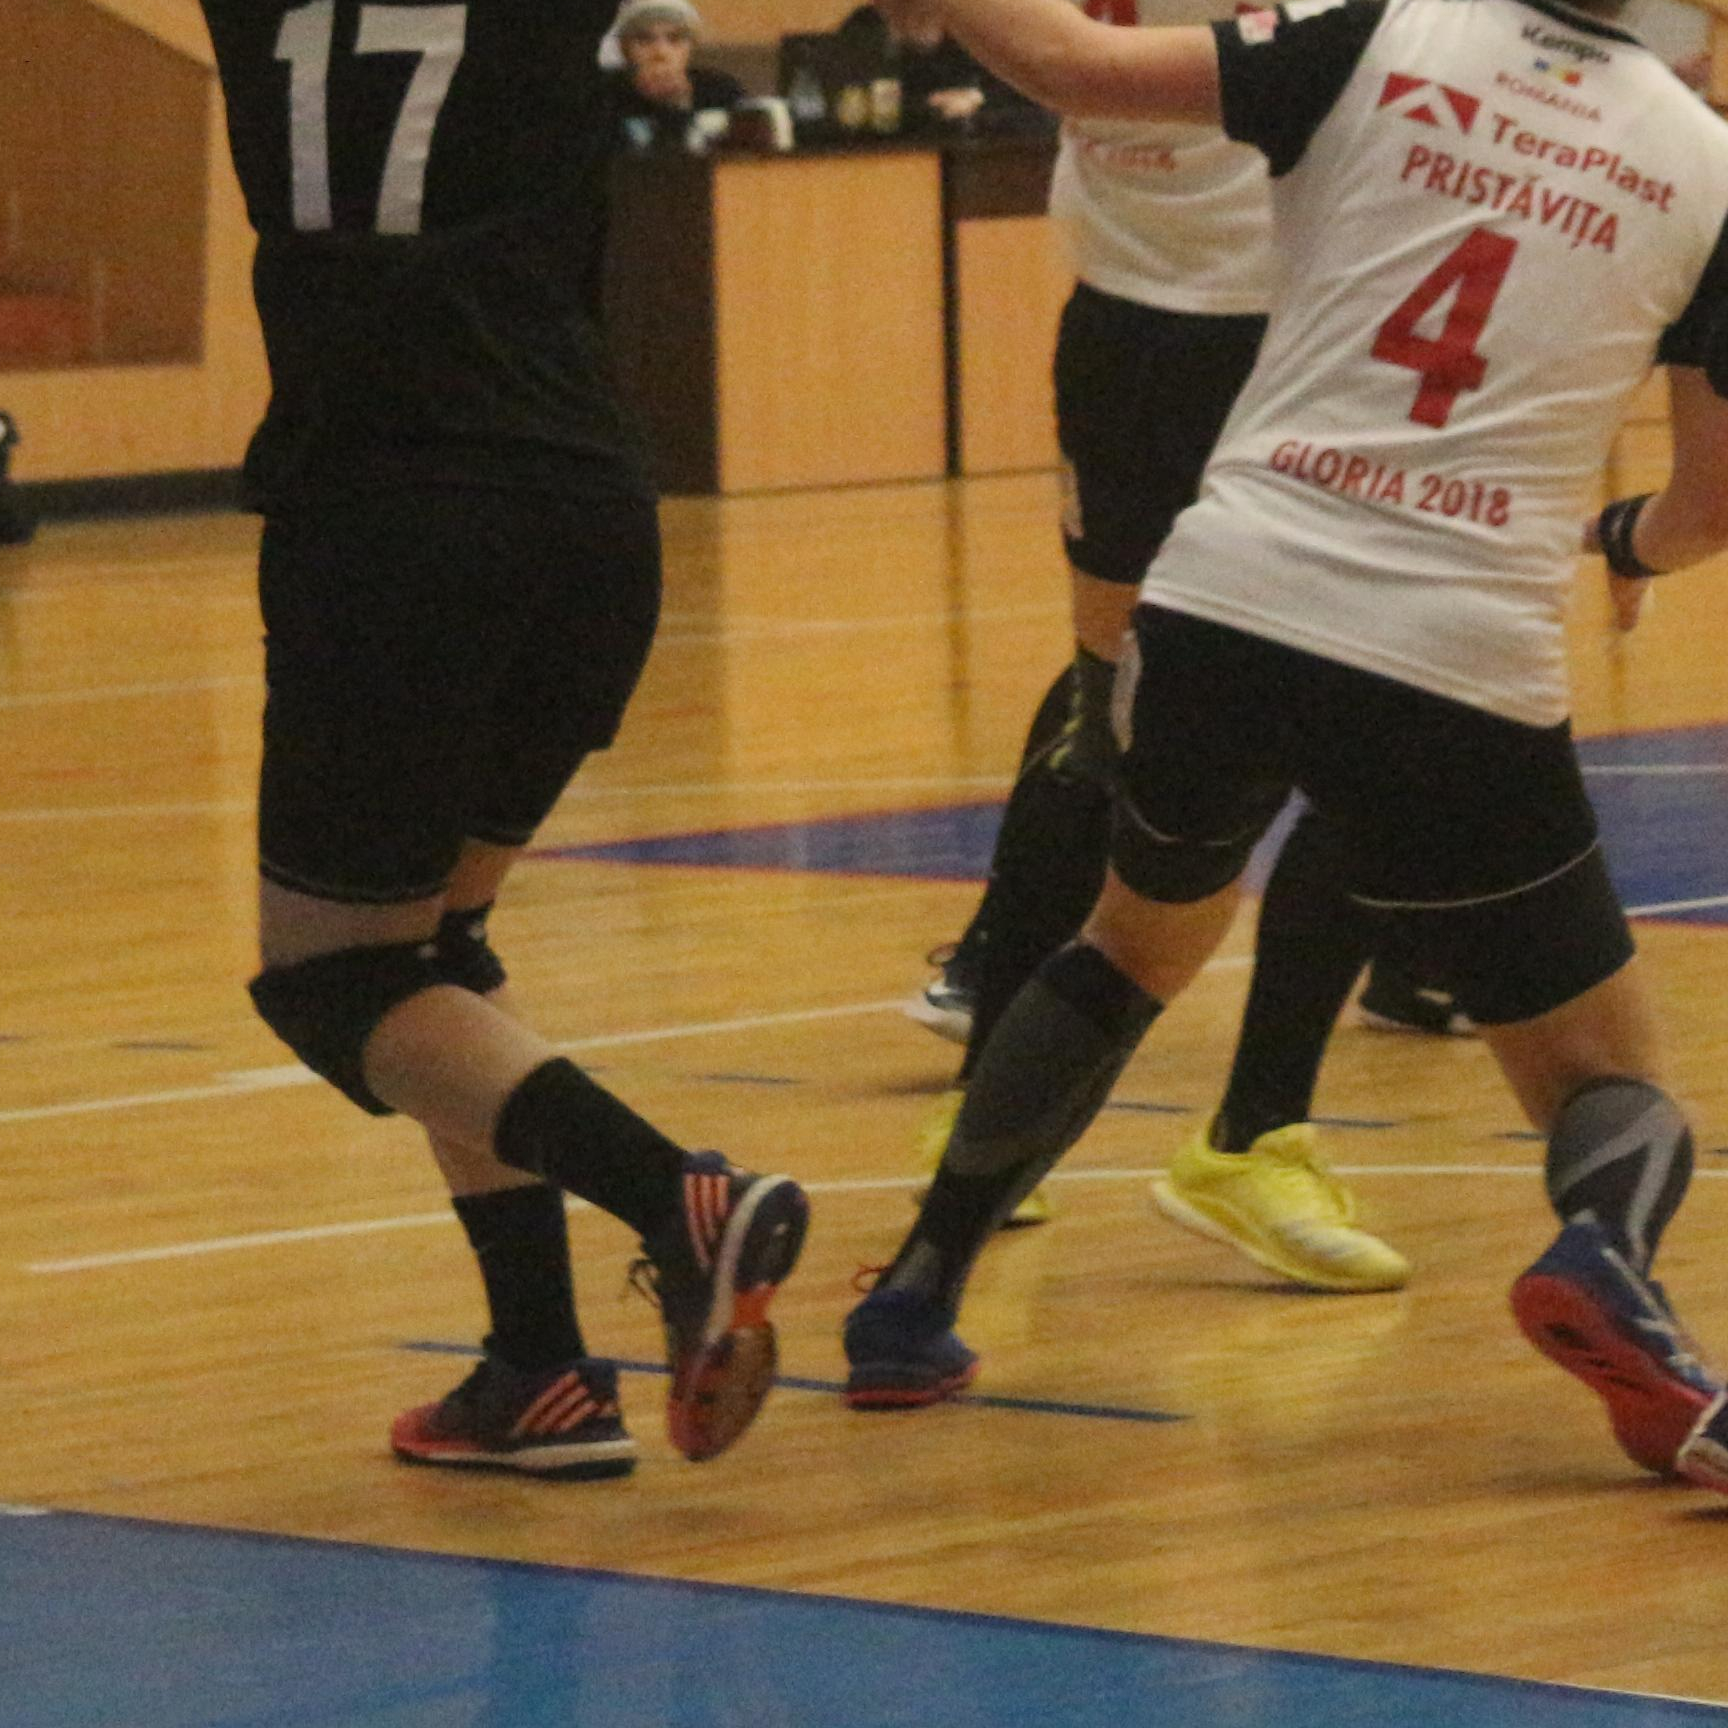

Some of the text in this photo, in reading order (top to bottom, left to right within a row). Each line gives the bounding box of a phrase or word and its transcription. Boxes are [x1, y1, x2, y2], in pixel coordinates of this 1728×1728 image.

[1491, 112, 1677, 214] TeraPlast
[1371, 226, 1520, 430] 4
[1269, 440, 1513, 527] GLORIA 2018
